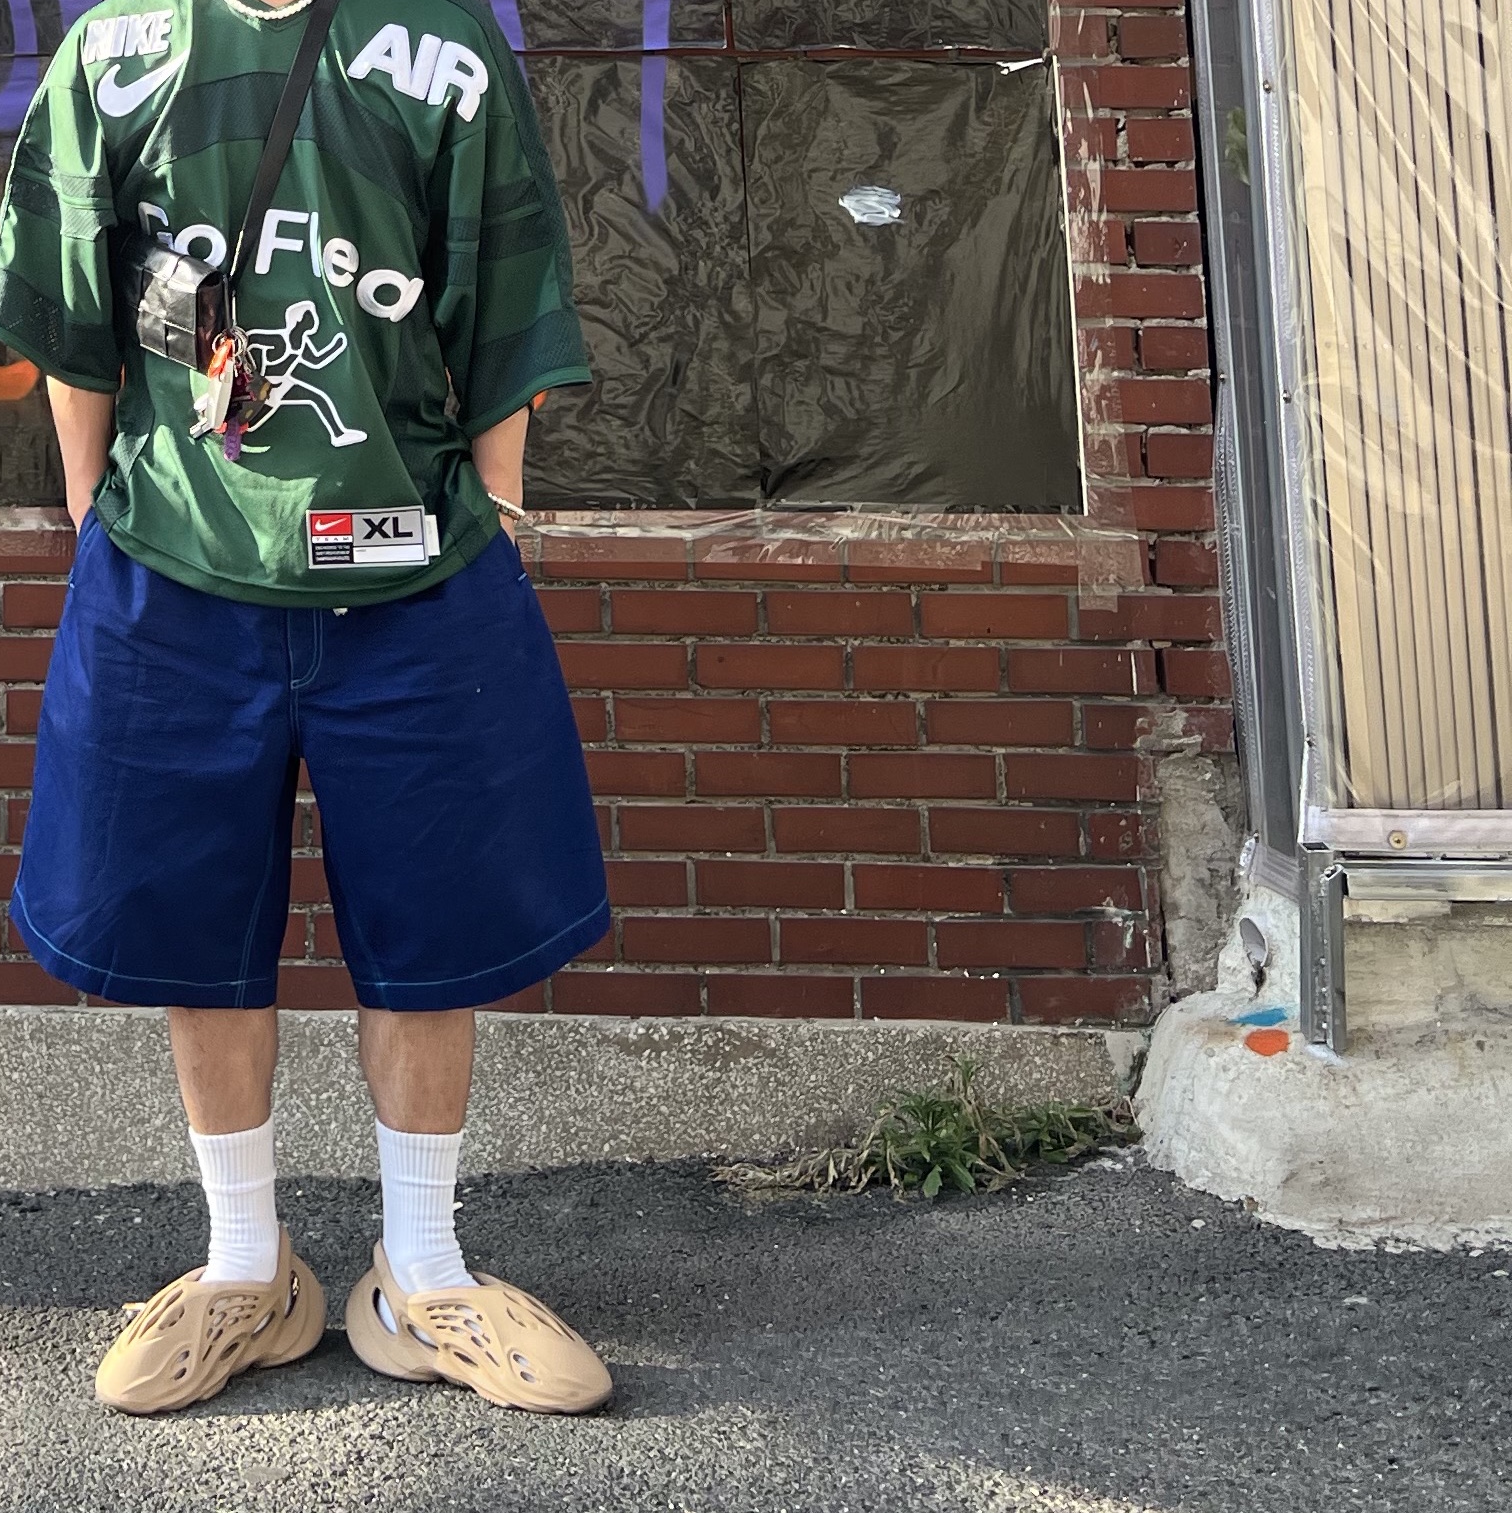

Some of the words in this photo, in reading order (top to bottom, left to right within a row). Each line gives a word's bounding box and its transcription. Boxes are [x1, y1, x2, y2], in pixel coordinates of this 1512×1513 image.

[81, 8, 174, 66] NIKE
[346, 23, 489, 123] AIR
[254, 207, 425, 324] Flea
[362, 516, 414, 540] XL
